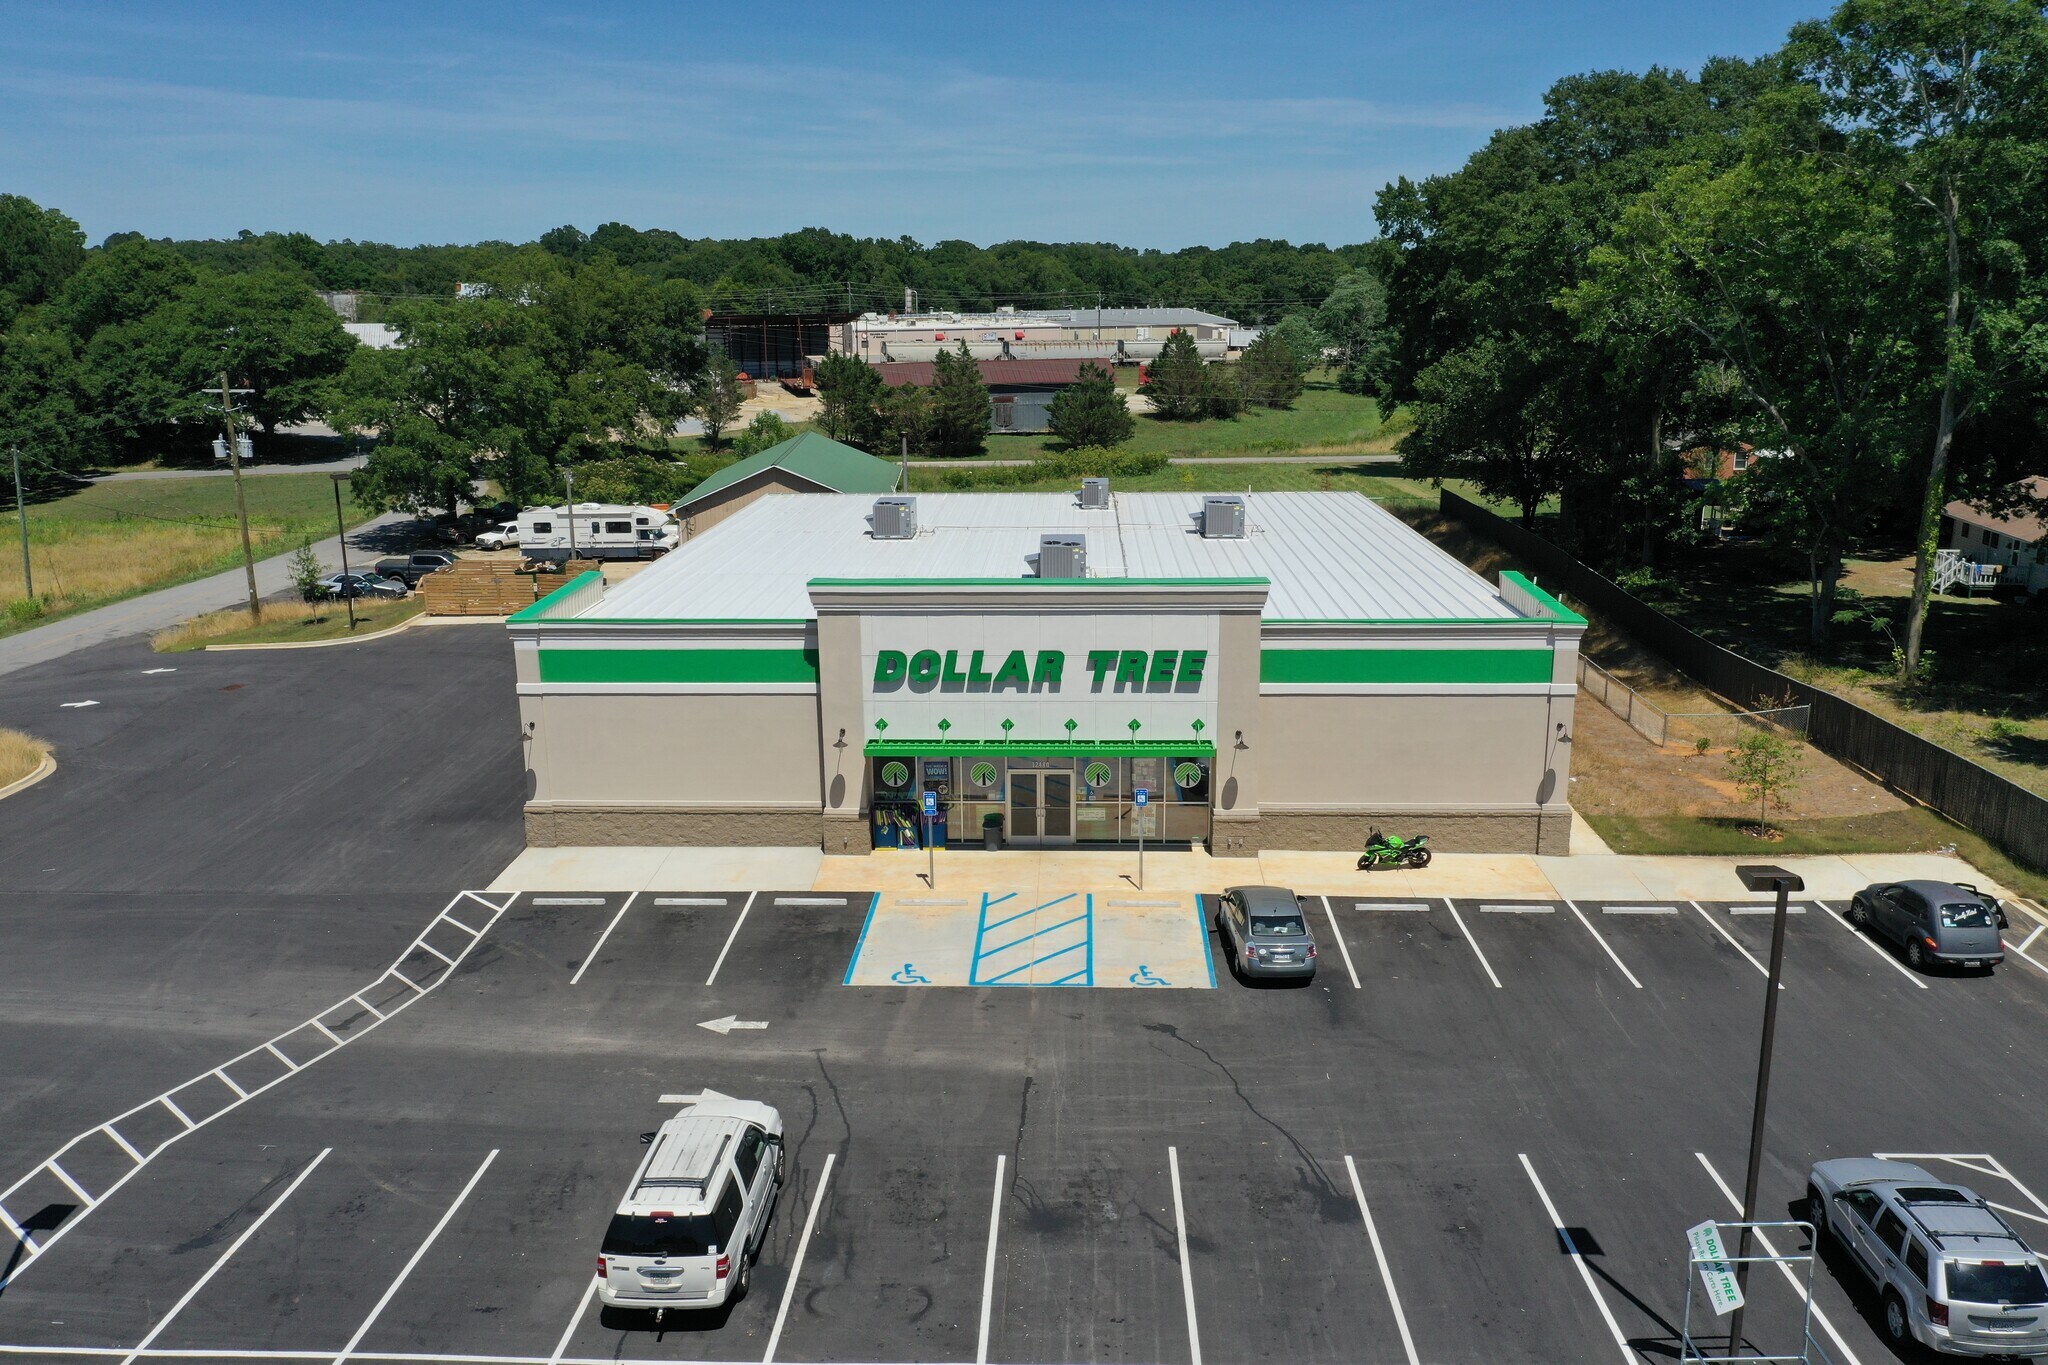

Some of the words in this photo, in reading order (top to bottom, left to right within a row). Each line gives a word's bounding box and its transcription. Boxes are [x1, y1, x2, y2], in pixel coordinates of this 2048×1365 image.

[874, 650, 1065, 688] DOLLAR
[1086, 650, 1208, 688] TREE
[926, 768, 947, 776] WOW!
[1706, 1271, 1715, 1290] Carts
[1720, 1277, 1737, 1302] TREE
